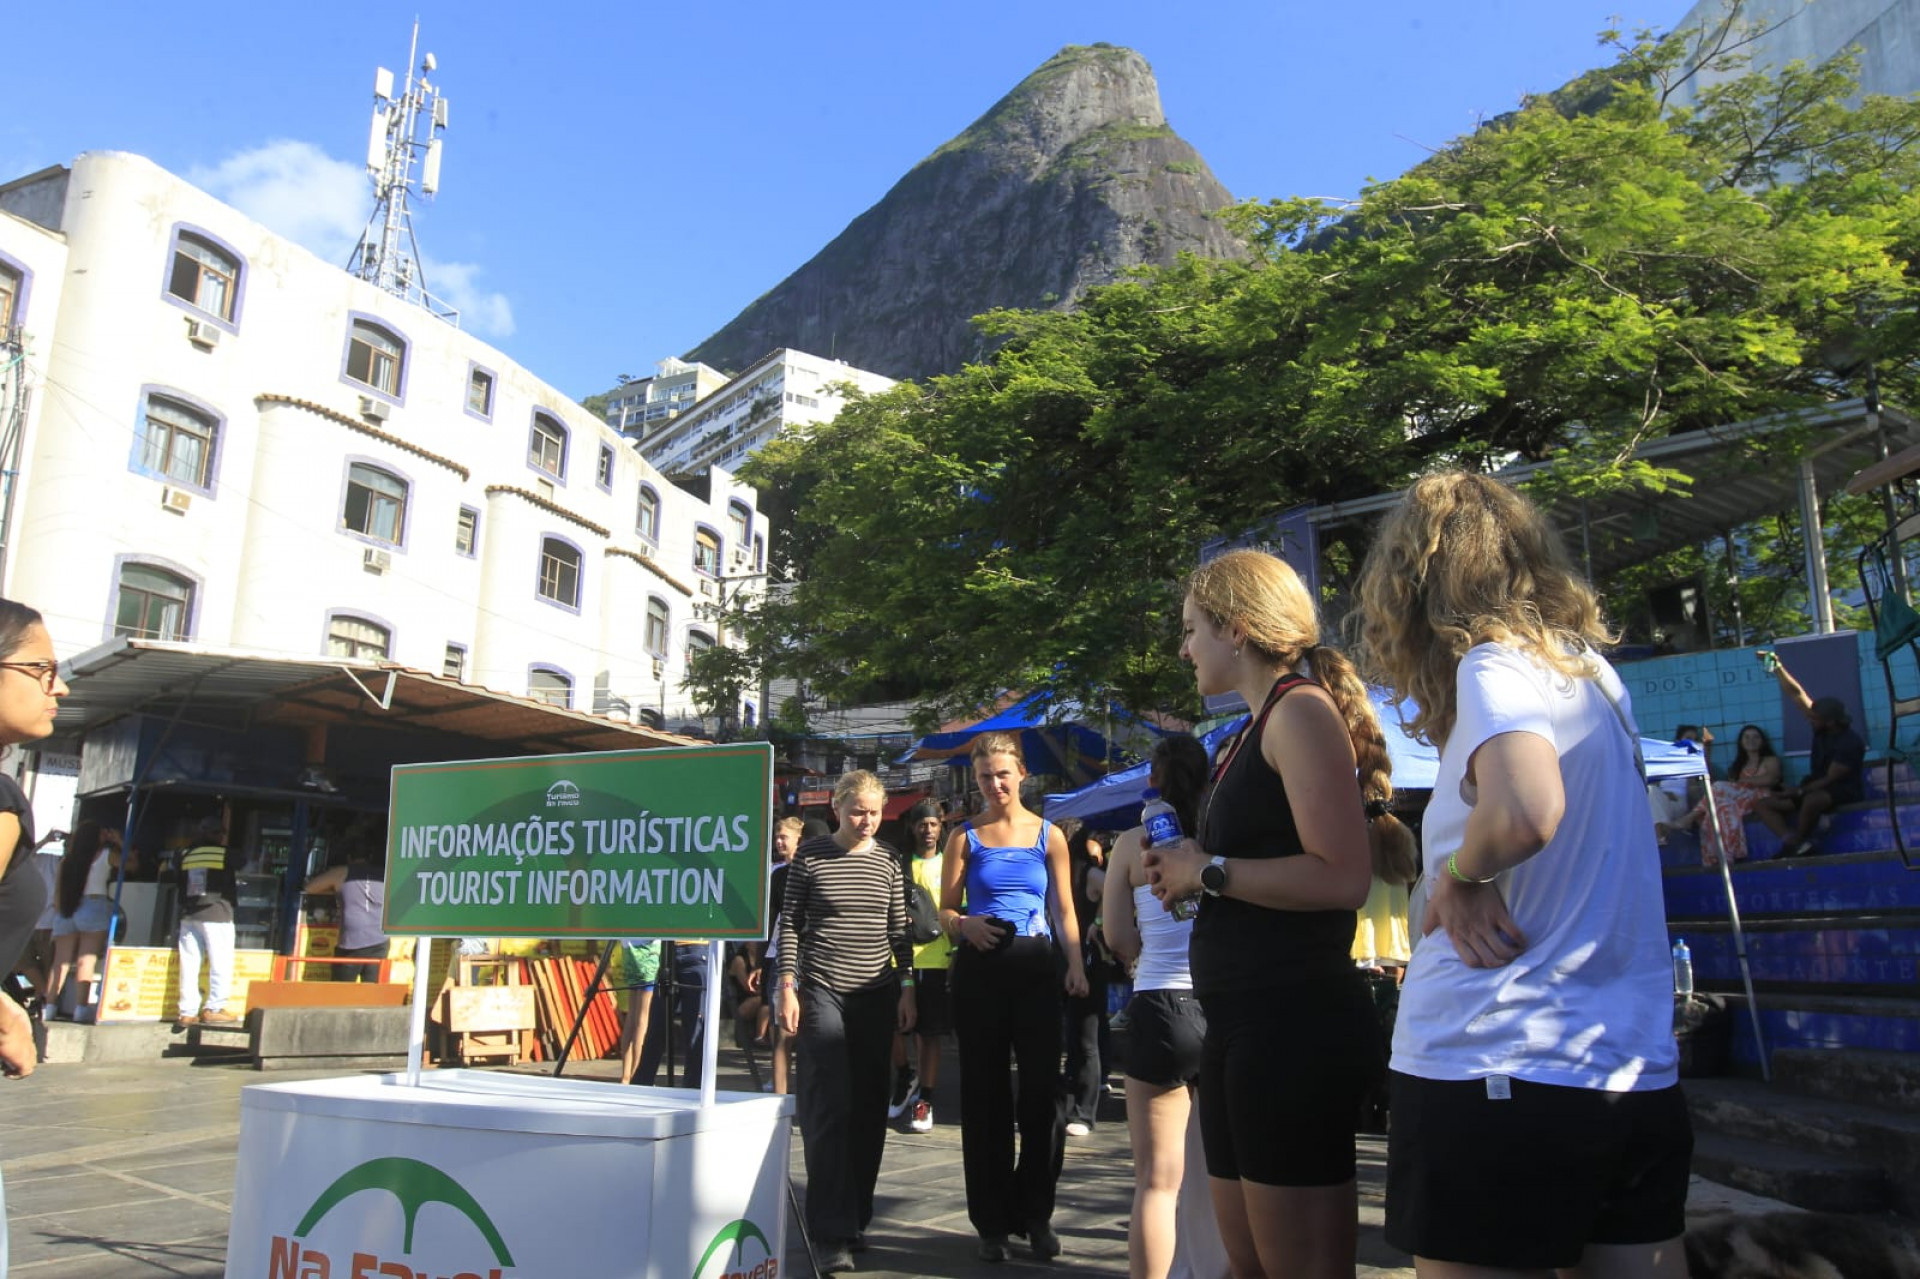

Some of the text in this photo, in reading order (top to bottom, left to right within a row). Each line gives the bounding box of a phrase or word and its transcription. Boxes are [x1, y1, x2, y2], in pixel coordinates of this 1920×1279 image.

[1645, 676, 1694, 693] DOS
[400, 811, 750, 865] INFORMAÇÕES TURÍSTICAS
[417, 868, 725, 905] TOURIST INFORMATION
